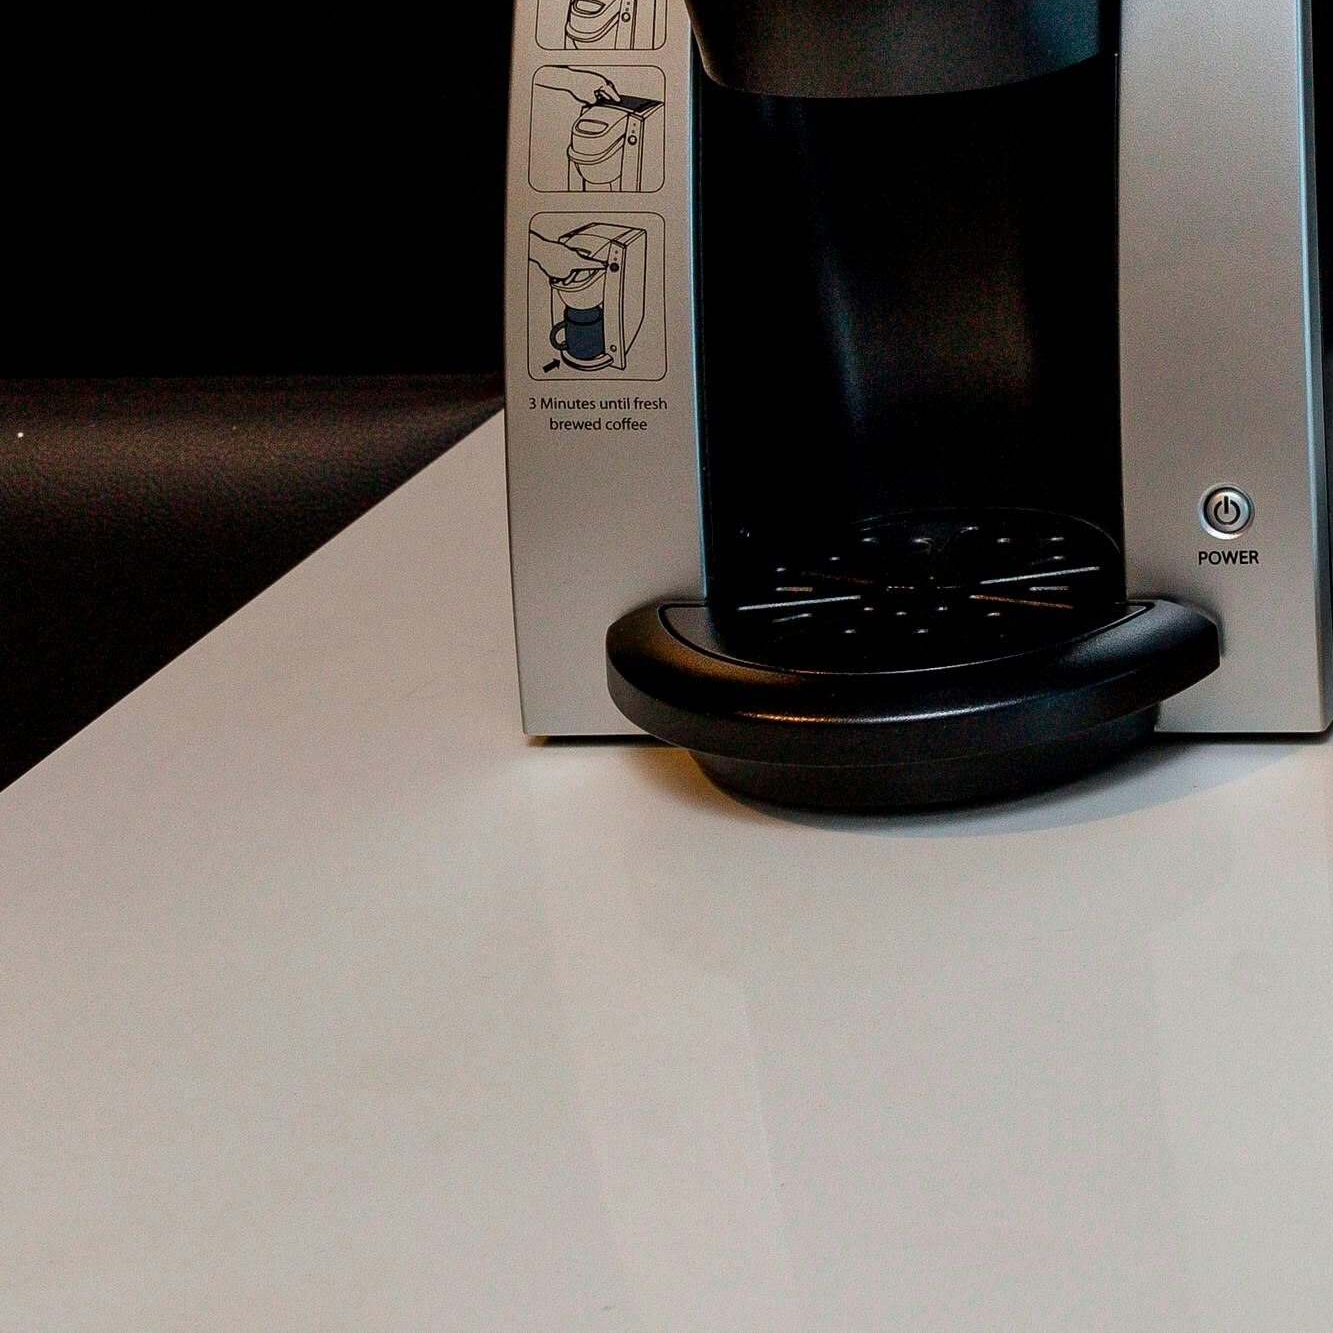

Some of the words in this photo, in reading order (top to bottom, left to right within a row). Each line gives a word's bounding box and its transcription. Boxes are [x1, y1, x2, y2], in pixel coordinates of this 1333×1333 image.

[529, 398, 537, 410] 3
[540, 397, 596, 410] Minutes
[599, 397, 631, 410] until
[633, 397, 668, 410] fresh
[549, 417, 601, 431] brewed
[605, 417, 648, 431] coffee
[1198, 550, 1260, 565] POWER
